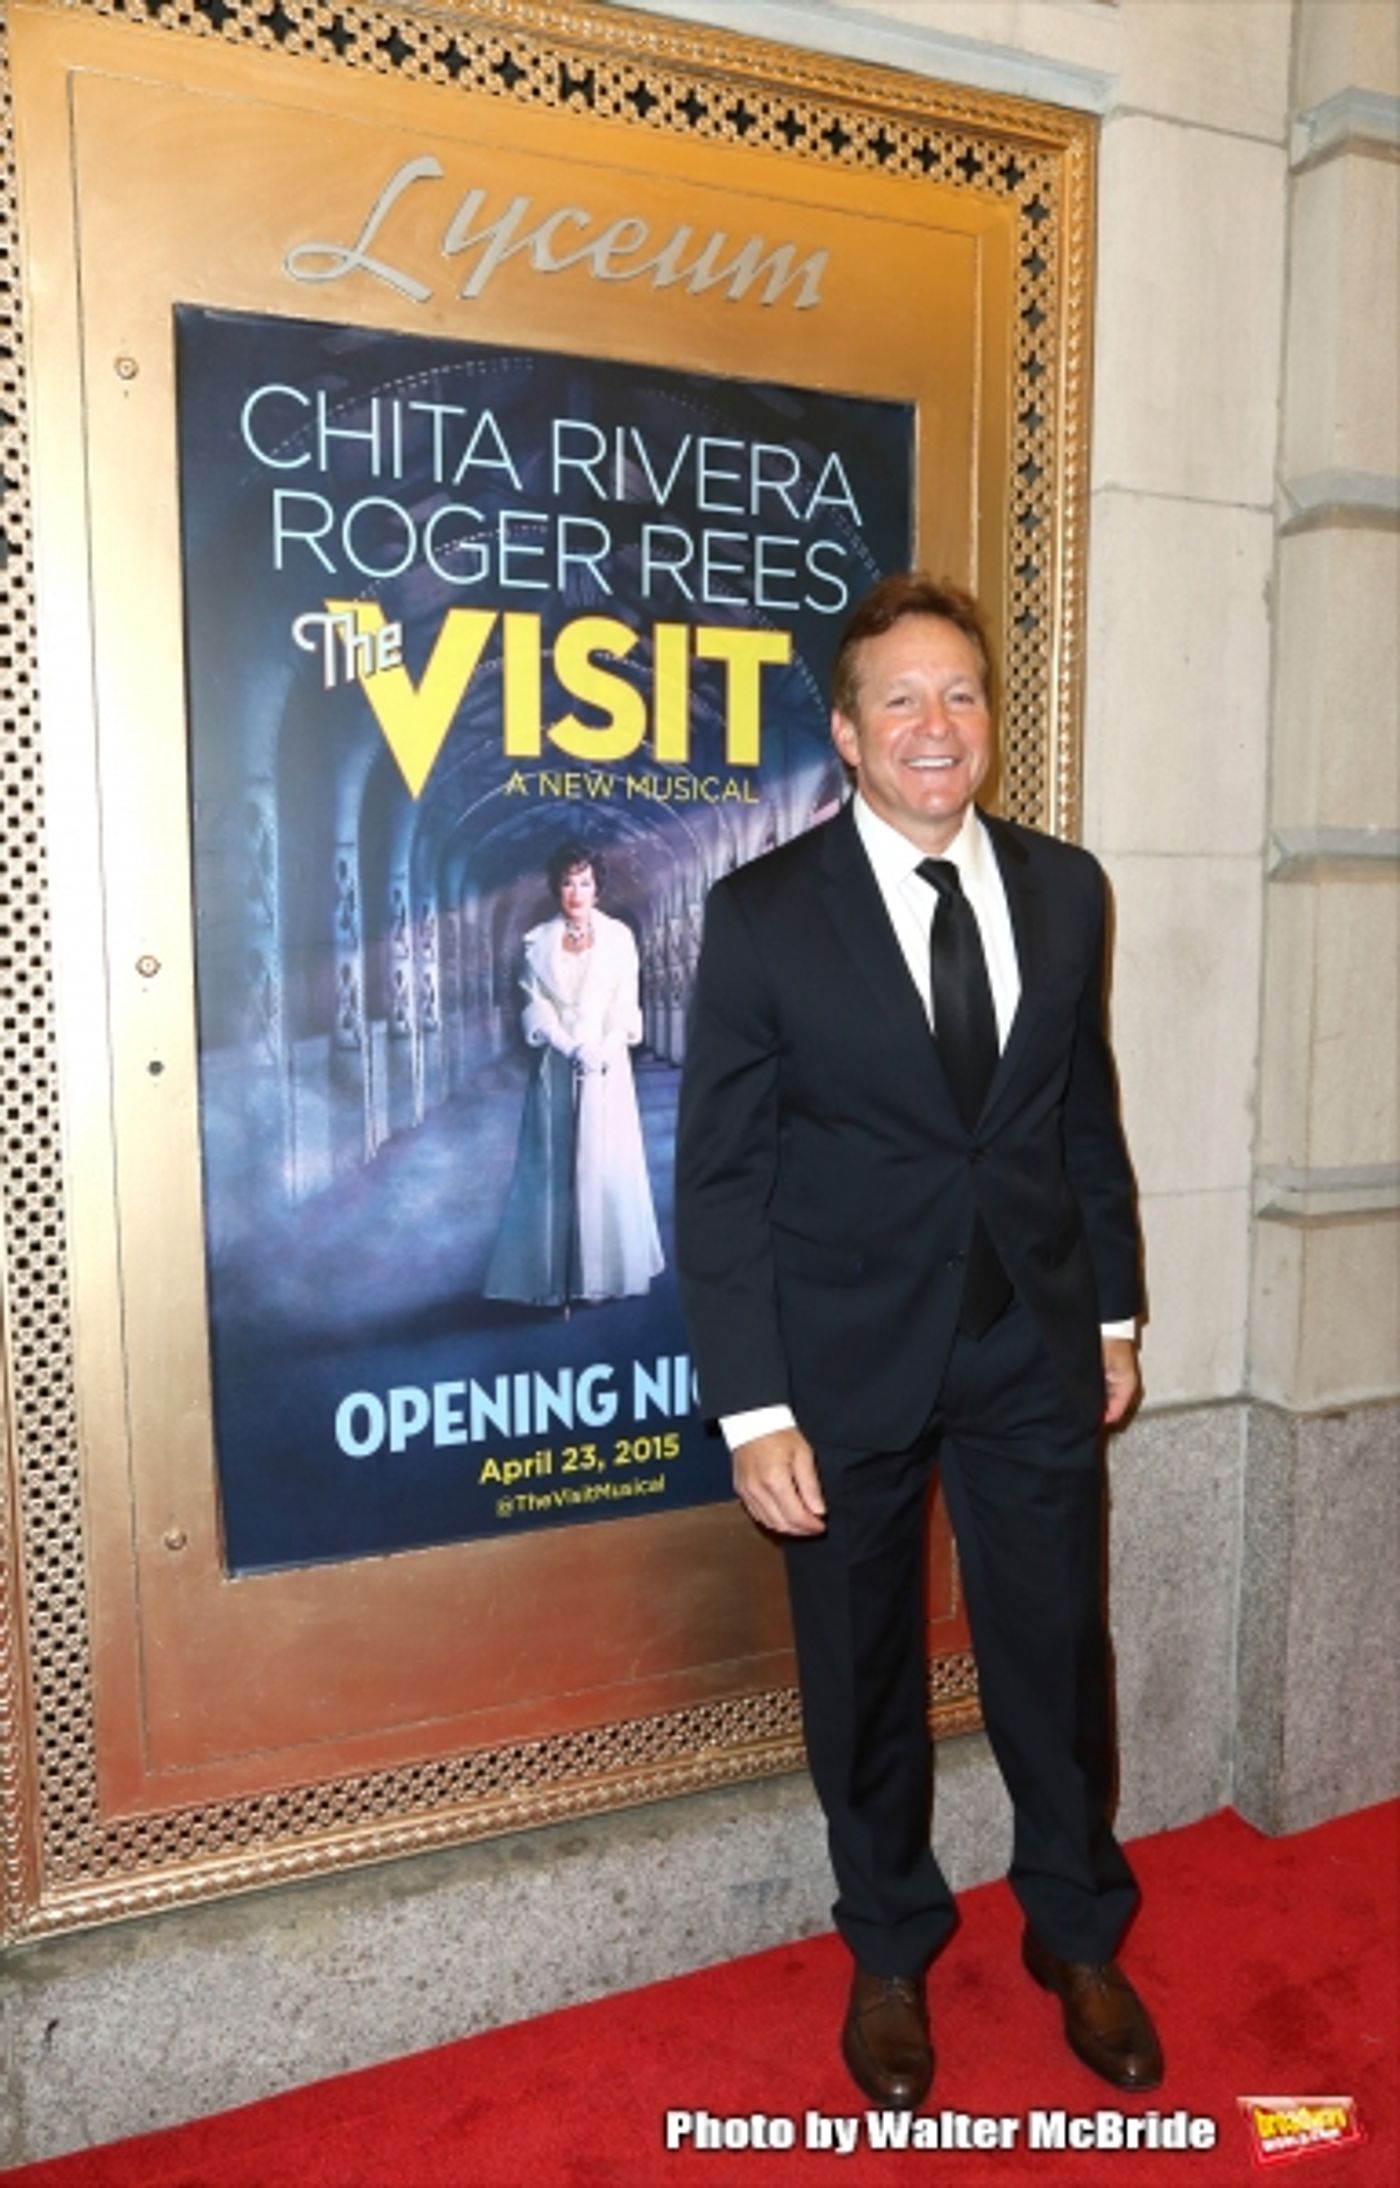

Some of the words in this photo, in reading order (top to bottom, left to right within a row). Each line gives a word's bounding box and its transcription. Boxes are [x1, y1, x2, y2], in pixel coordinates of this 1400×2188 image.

[284, 155, 829, 309] Lyceum
[241, 384, 523, 491] CHITA
[552, 418, 863, 526] RIVERA
[273, 488, 612, 597] ROGER
[641, 524, 848, 614] REES
[292, 608, 403, 689] The
[323, 598, 791, 800] VISIT
[504, 772, 527, 797] A
[540, 774, 613, 799] NEW
[626, 774, 759, 803] MUSICAL
[335, 1363, 618, 1457] OPENING
[633, 1354, 700, 1421] NI
[478, 1449, 553, 1485] April
[561, 1444, 604, 1473] 23,
[613, 1433, 681, 1467] 2015
[496, 1474, 666, 1518] @TheVisitMusical
